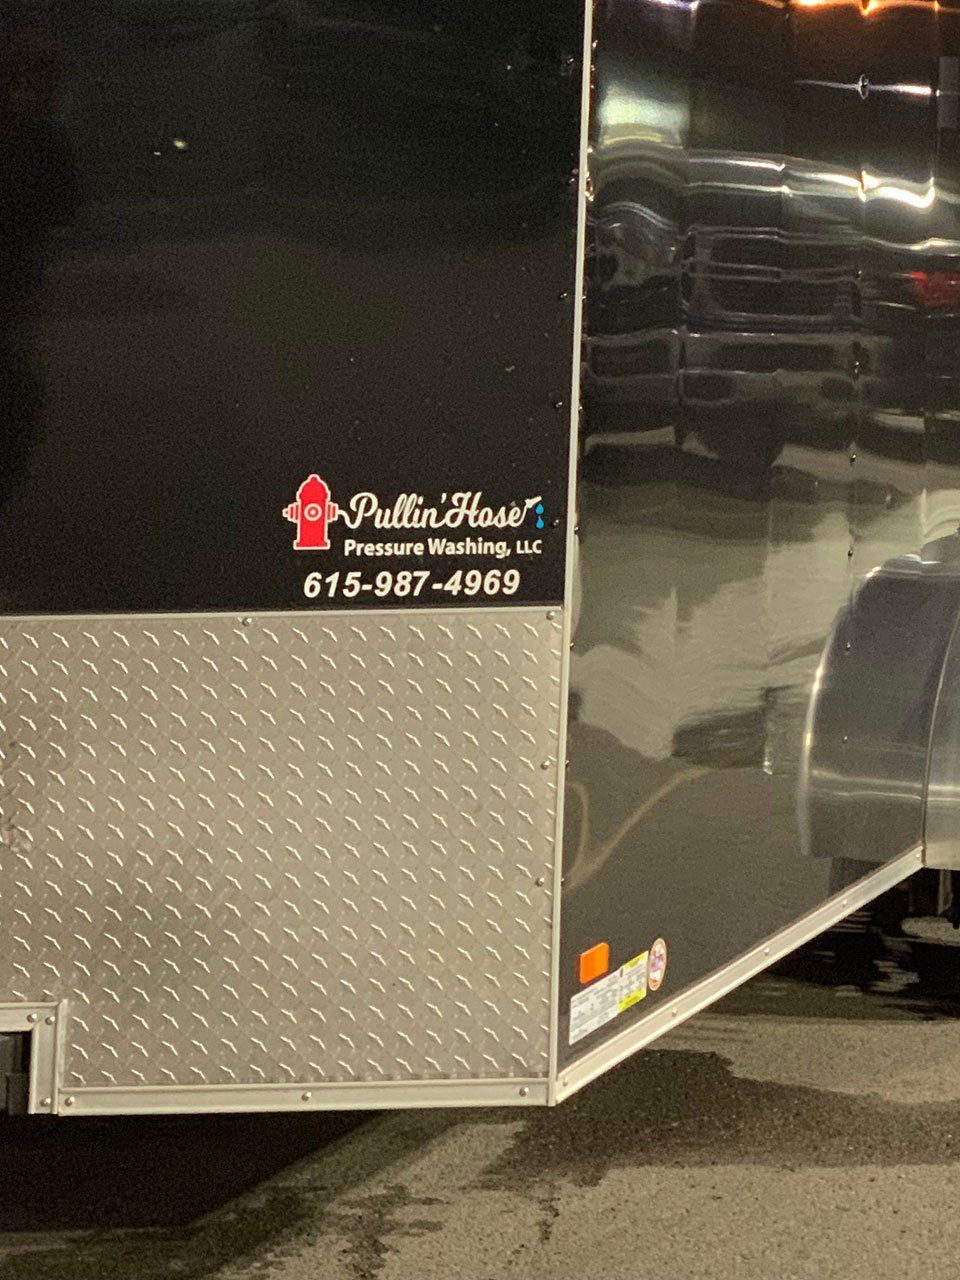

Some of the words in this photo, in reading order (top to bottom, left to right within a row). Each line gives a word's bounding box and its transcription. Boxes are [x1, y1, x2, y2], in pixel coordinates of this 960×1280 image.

[344, 539, 424, 556] Pressure
[428, 537, 511, 559] Washing,
[516, 540, 542, 554] LLC
[303, 570, 520, 598] 615-987-4969
